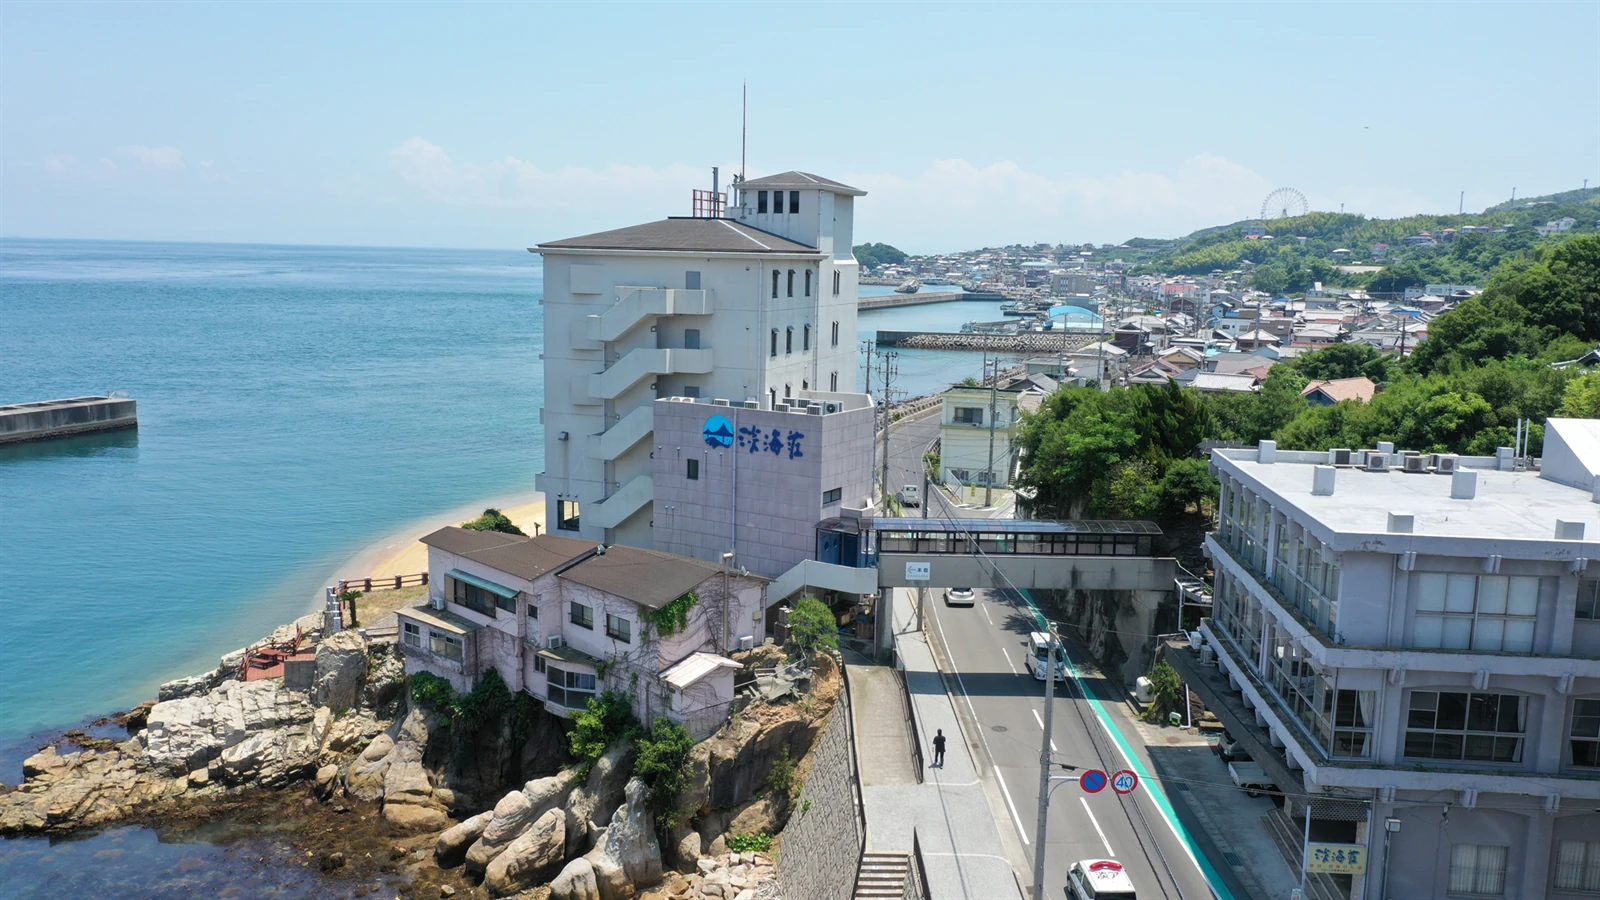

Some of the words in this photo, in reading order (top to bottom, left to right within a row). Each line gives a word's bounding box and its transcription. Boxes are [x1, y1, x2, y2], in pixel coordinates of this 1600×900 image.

[738, 425, 805, 460] 淡海荘
[1116, 776, 1133, 789] 40
[1315, 848, 1360, 864] 淡海荘
